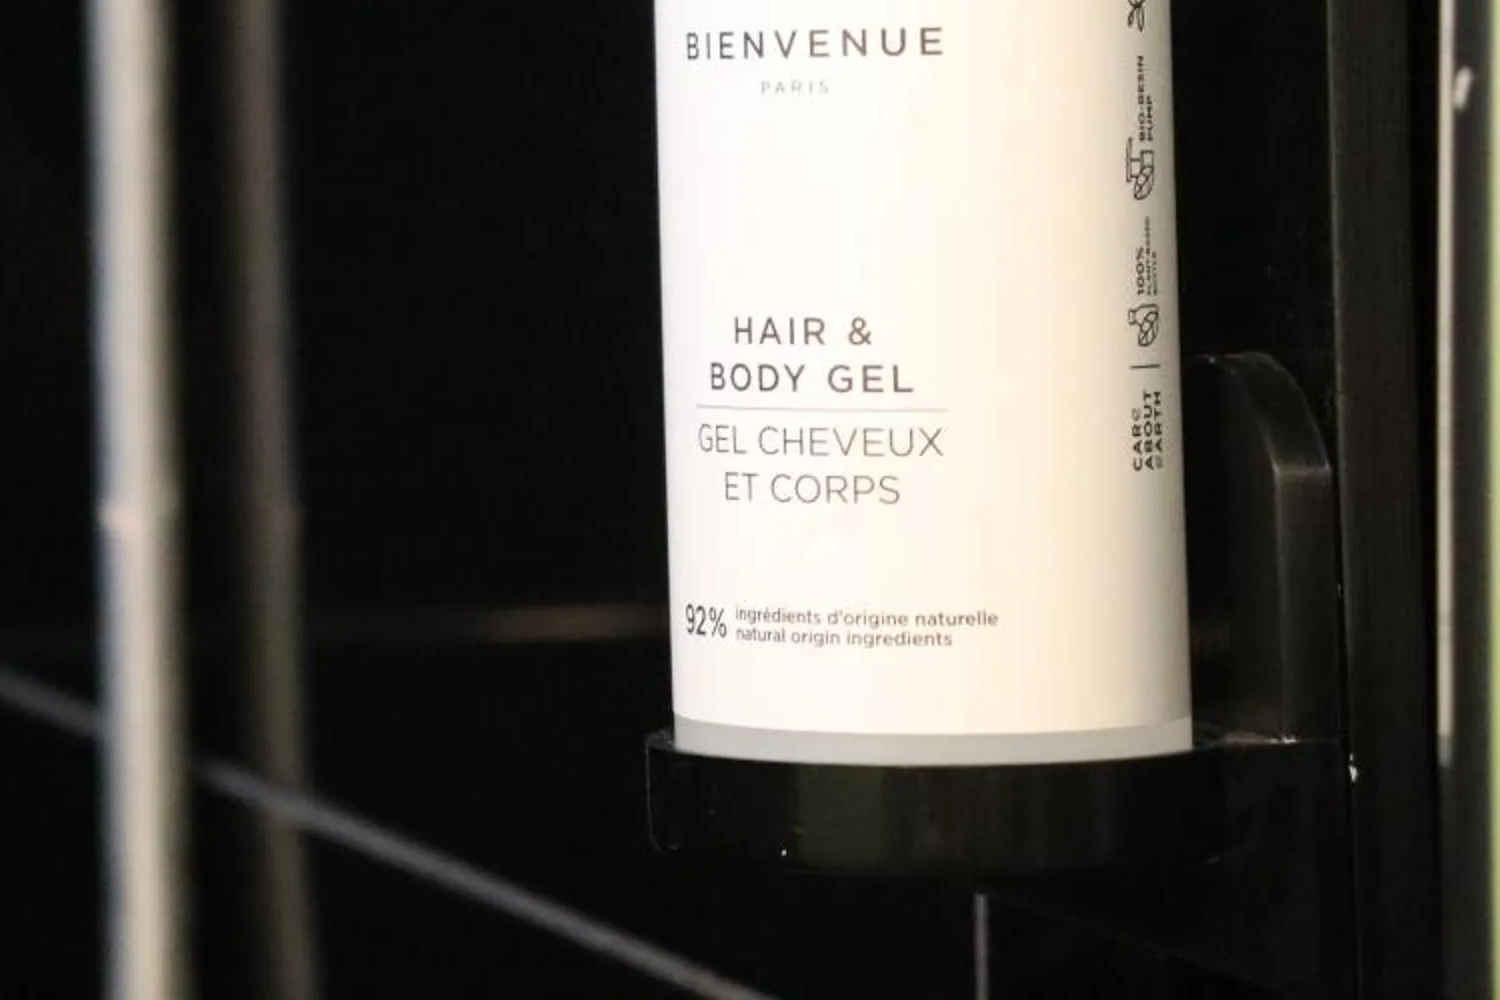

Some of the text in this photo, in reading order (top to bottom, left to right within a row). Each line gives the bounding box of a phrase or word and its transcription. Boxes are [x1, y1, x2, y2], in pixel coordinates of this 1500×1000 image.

[686, 27, 943, 60] BIENVENUE
[760, 79, 830, 95] PARIS
[734, 316, 873, 346] HAIR &
[710, 362, 914, 393] BODY GEL
[698, 423, 944, 457] GEL CHEVEUX
[724, 471, 901, 505] ET CORPS
[685, 604, 727, 638] 92%
[735, 606, 999, 628] ingrédients d'origine naturelle
[735, 626, 953, 648] natural origin ingredients
